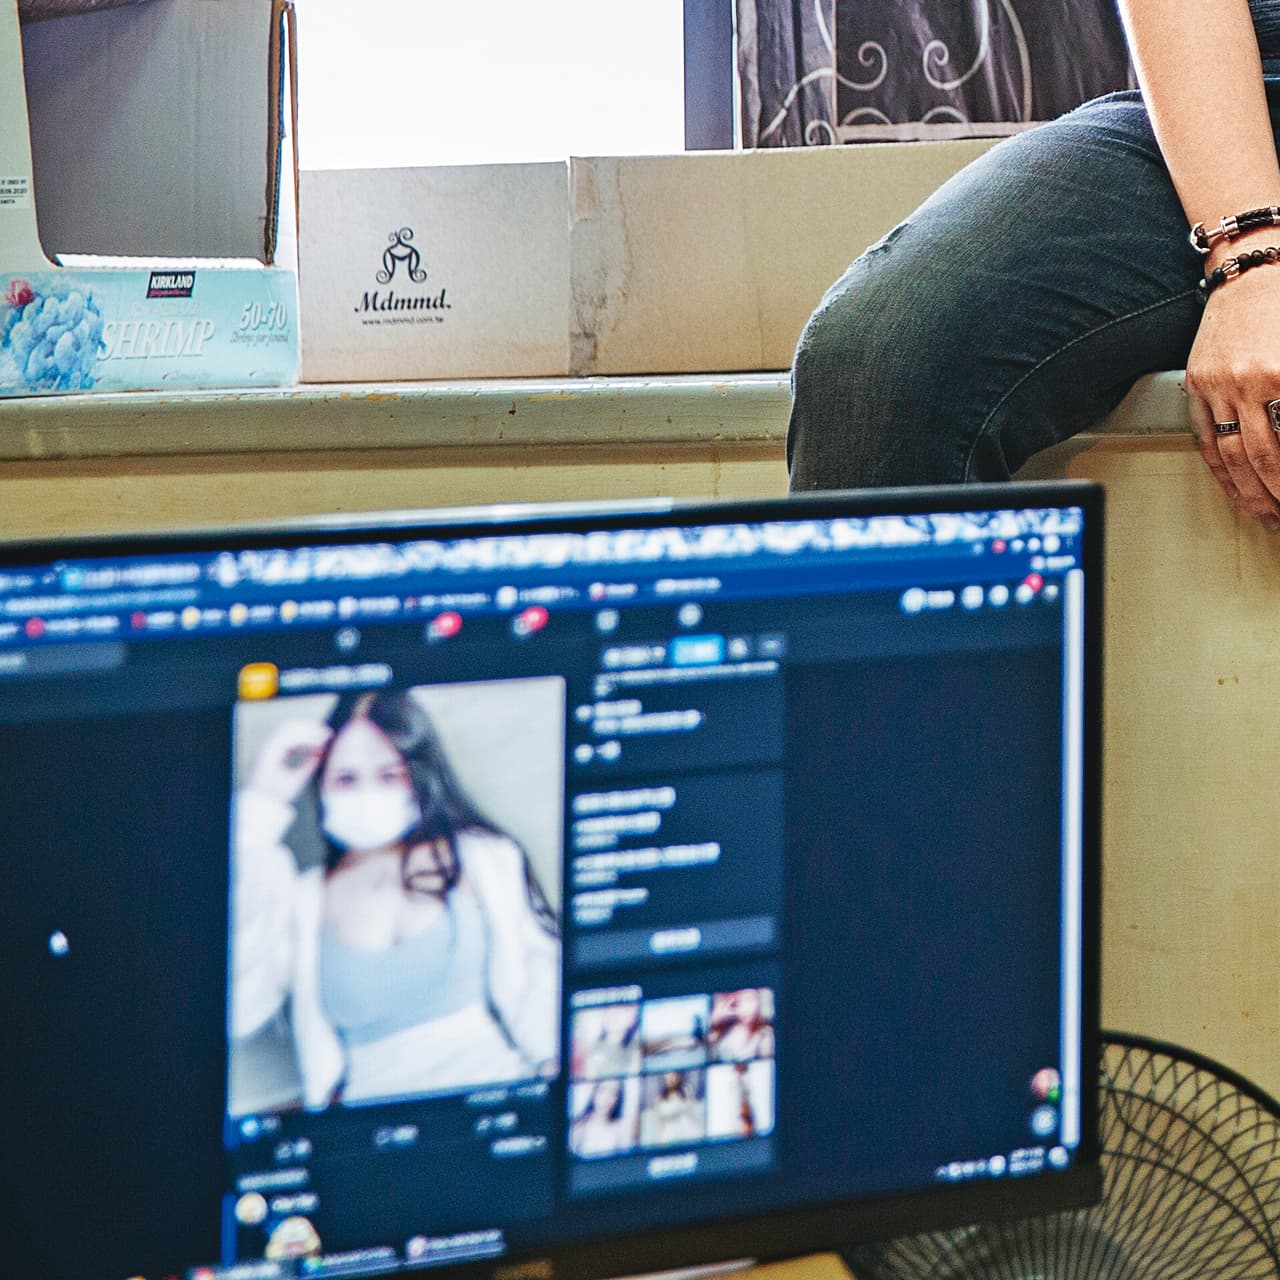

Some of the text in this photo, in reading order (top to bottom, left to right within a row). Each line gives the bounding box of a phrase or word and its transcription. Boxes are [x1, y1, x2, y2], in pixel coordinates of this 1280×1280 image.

[150, 274, 194, 289] KIRKLAND
[354, 288, 451, 312] Mdmmd.
[240, 301, 288, 332] 50-70
[96, 319, 216, 361] SHRIMP
